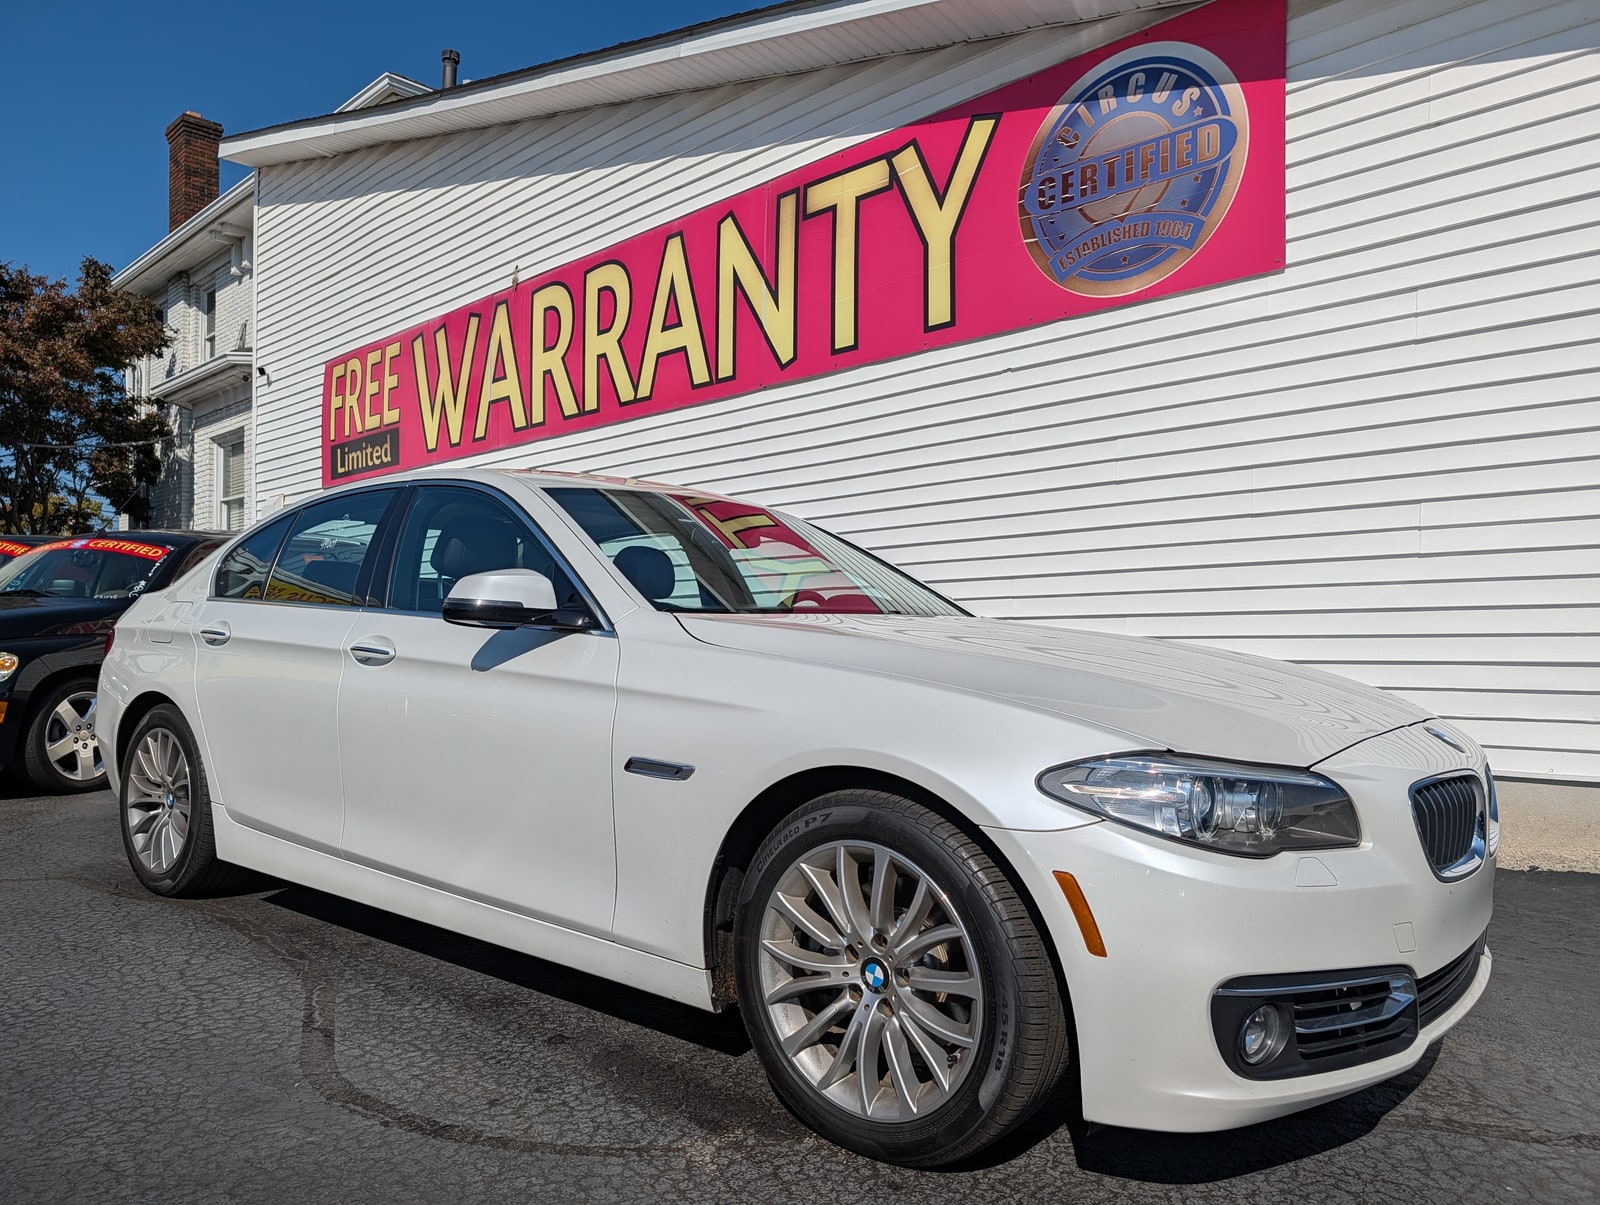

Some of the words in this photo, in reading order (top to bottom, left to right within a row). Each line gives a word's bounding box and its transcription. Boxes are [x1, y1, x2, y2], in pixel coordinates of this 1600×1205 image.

[1056, 72, 1201, 150] CIRCUS
[1037, 123, 1221, 211] CERTIFIED
[1058, 220, 1151, 271] ESTABLISHED
[1154, 219, 1194, 241] 1964
[330, 341, 401, 442] FREE
[410, 113, 1002, 453] WARRANTY
[336, 439, 392, 474] Limited
[88, 539, 163, 558] CERTIFIED
[804, 811, 833, 829] P7
